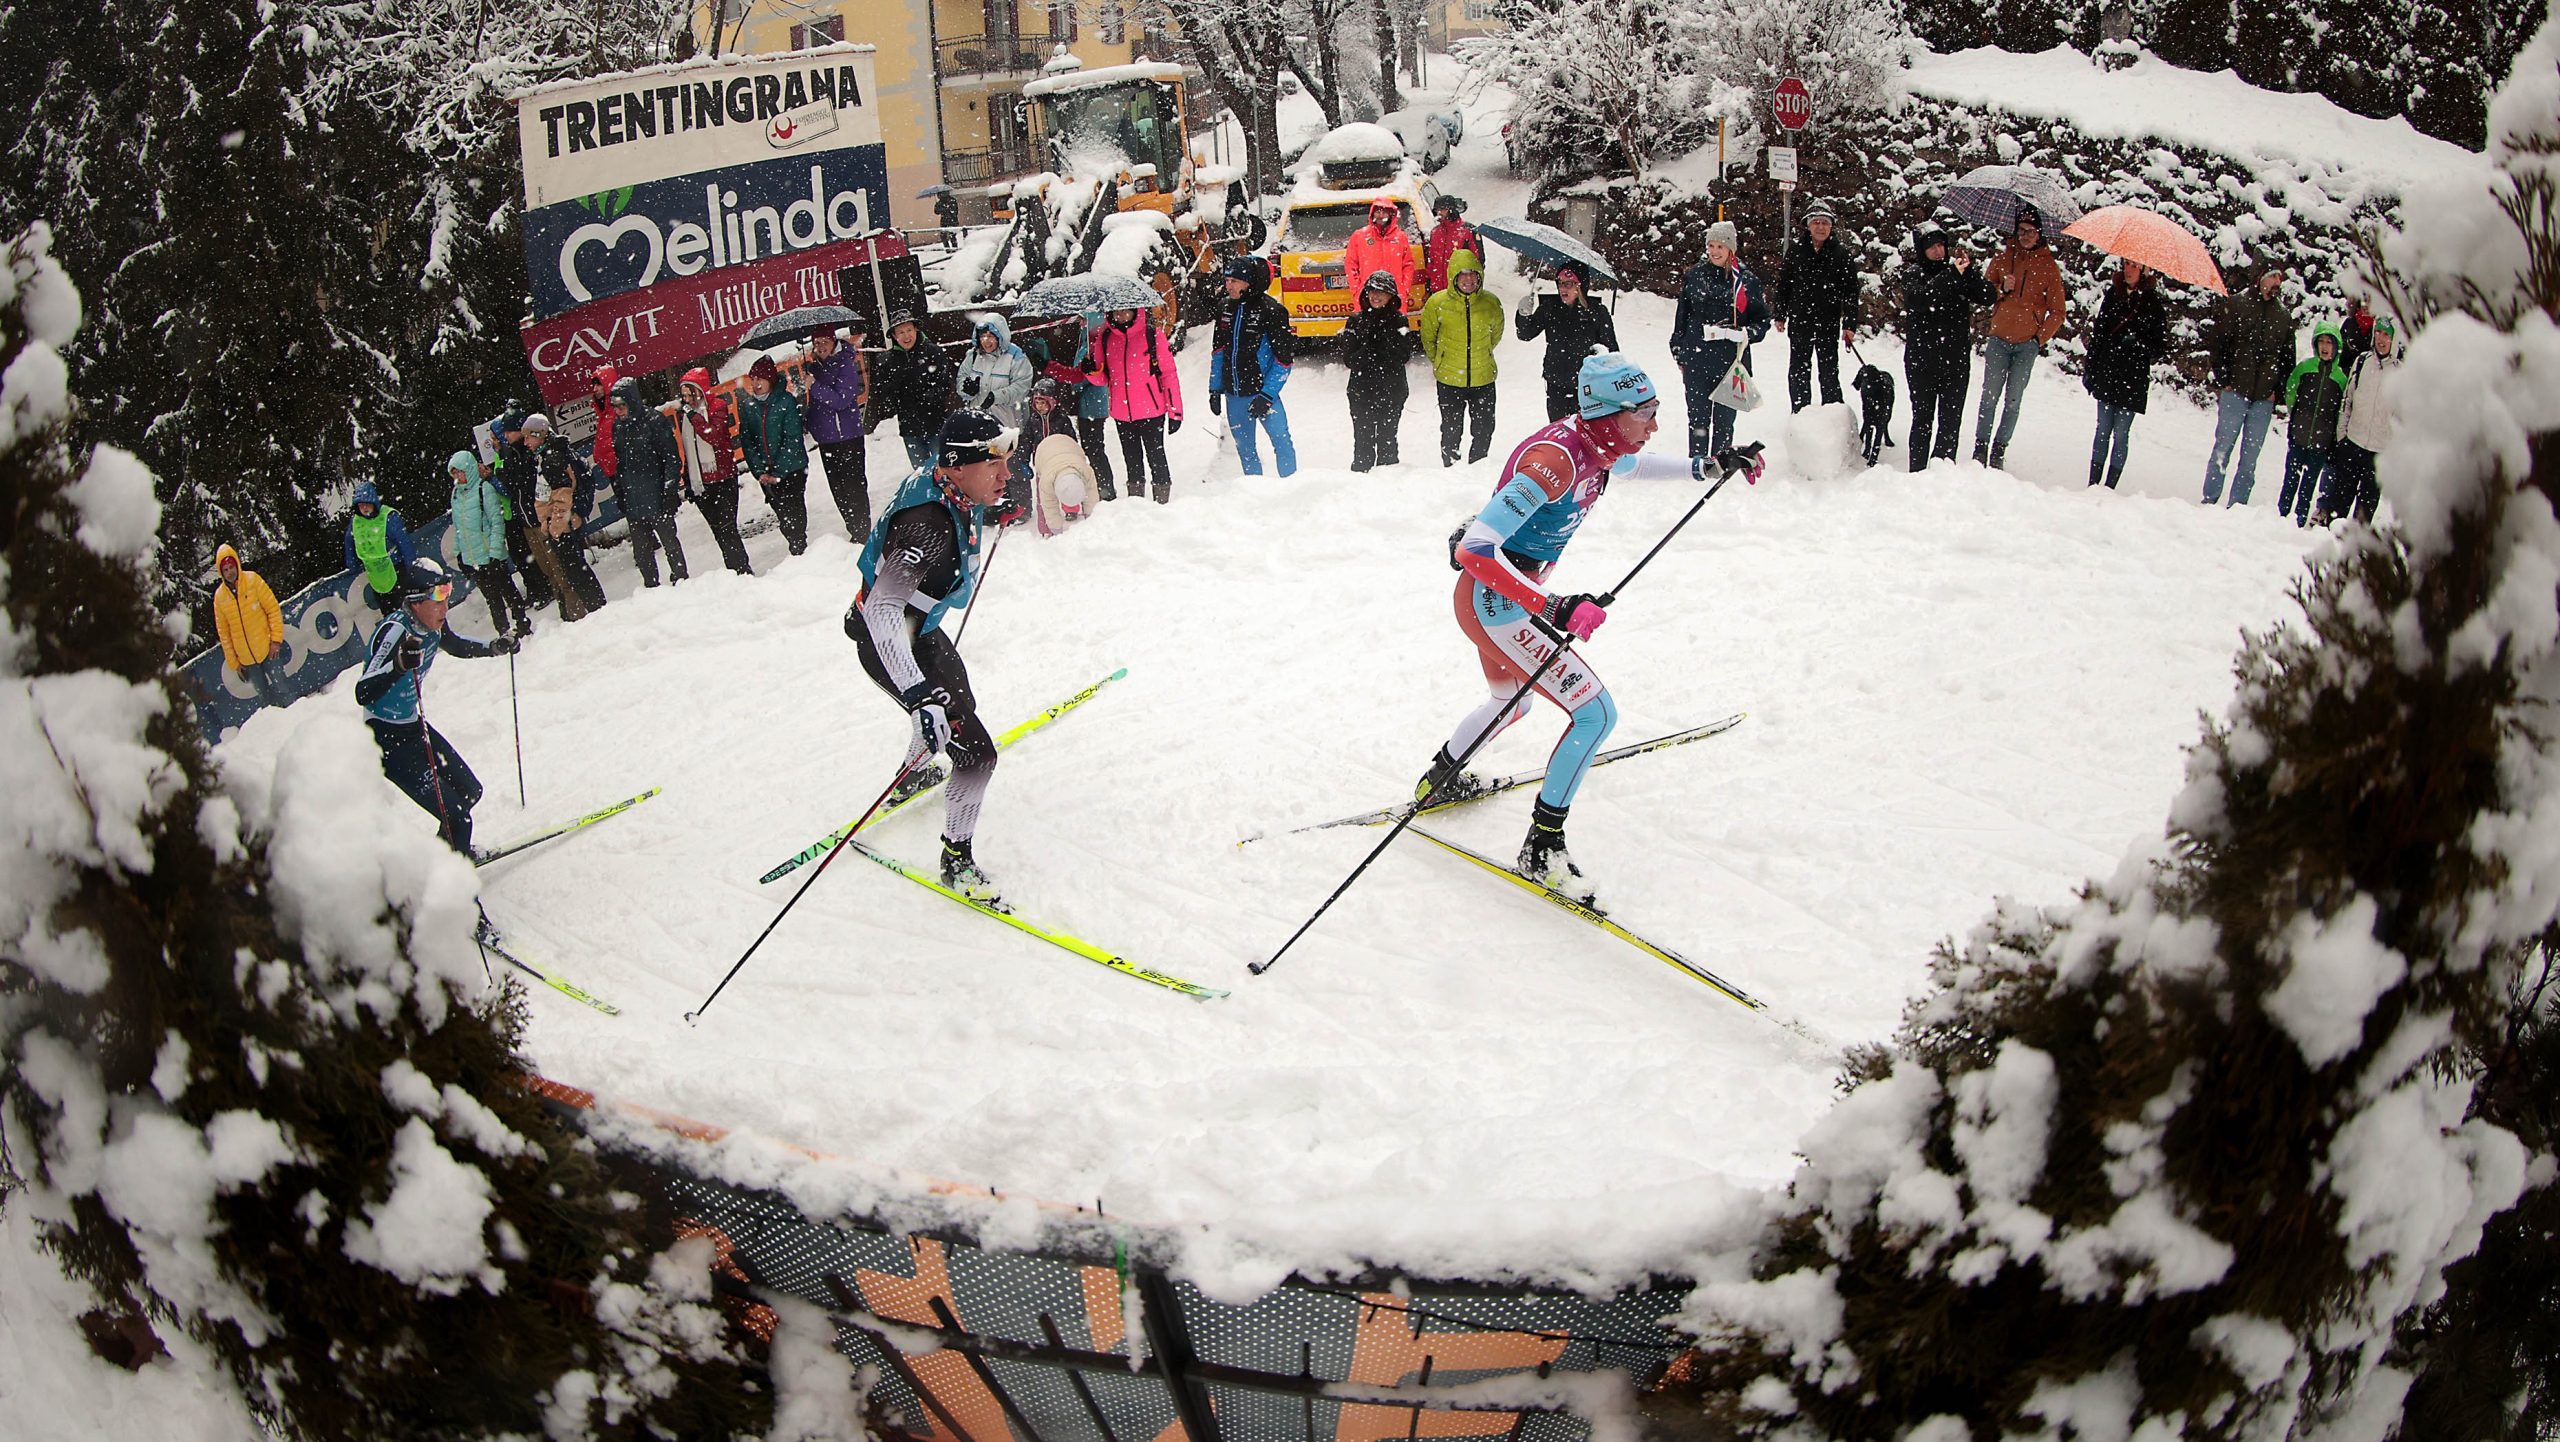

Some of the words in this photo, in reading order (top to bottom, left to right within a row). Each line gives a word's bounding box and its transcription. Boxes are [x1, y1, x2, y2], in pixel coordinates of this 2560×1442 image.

[539, 65, 862, 158] TRENTINGRANA
[1776, 92, 1809, 114] STOP
[696, 280, 789, 335] Müller
[1296, 303, 1355, 314] SOCCORS
[531, 304, 665, 372] CAVIT
[574, 354, 637, 382] TRNTO
[1531, 461, 1561, 489] SLAVIA
[1480, 585, 1496, 617] RENTINO
[1513, 628, 1568, 680] SLAVIA
[581, 800, 630, 824] FISCHE
[1544, 891, 1605, 925] FISCHER
